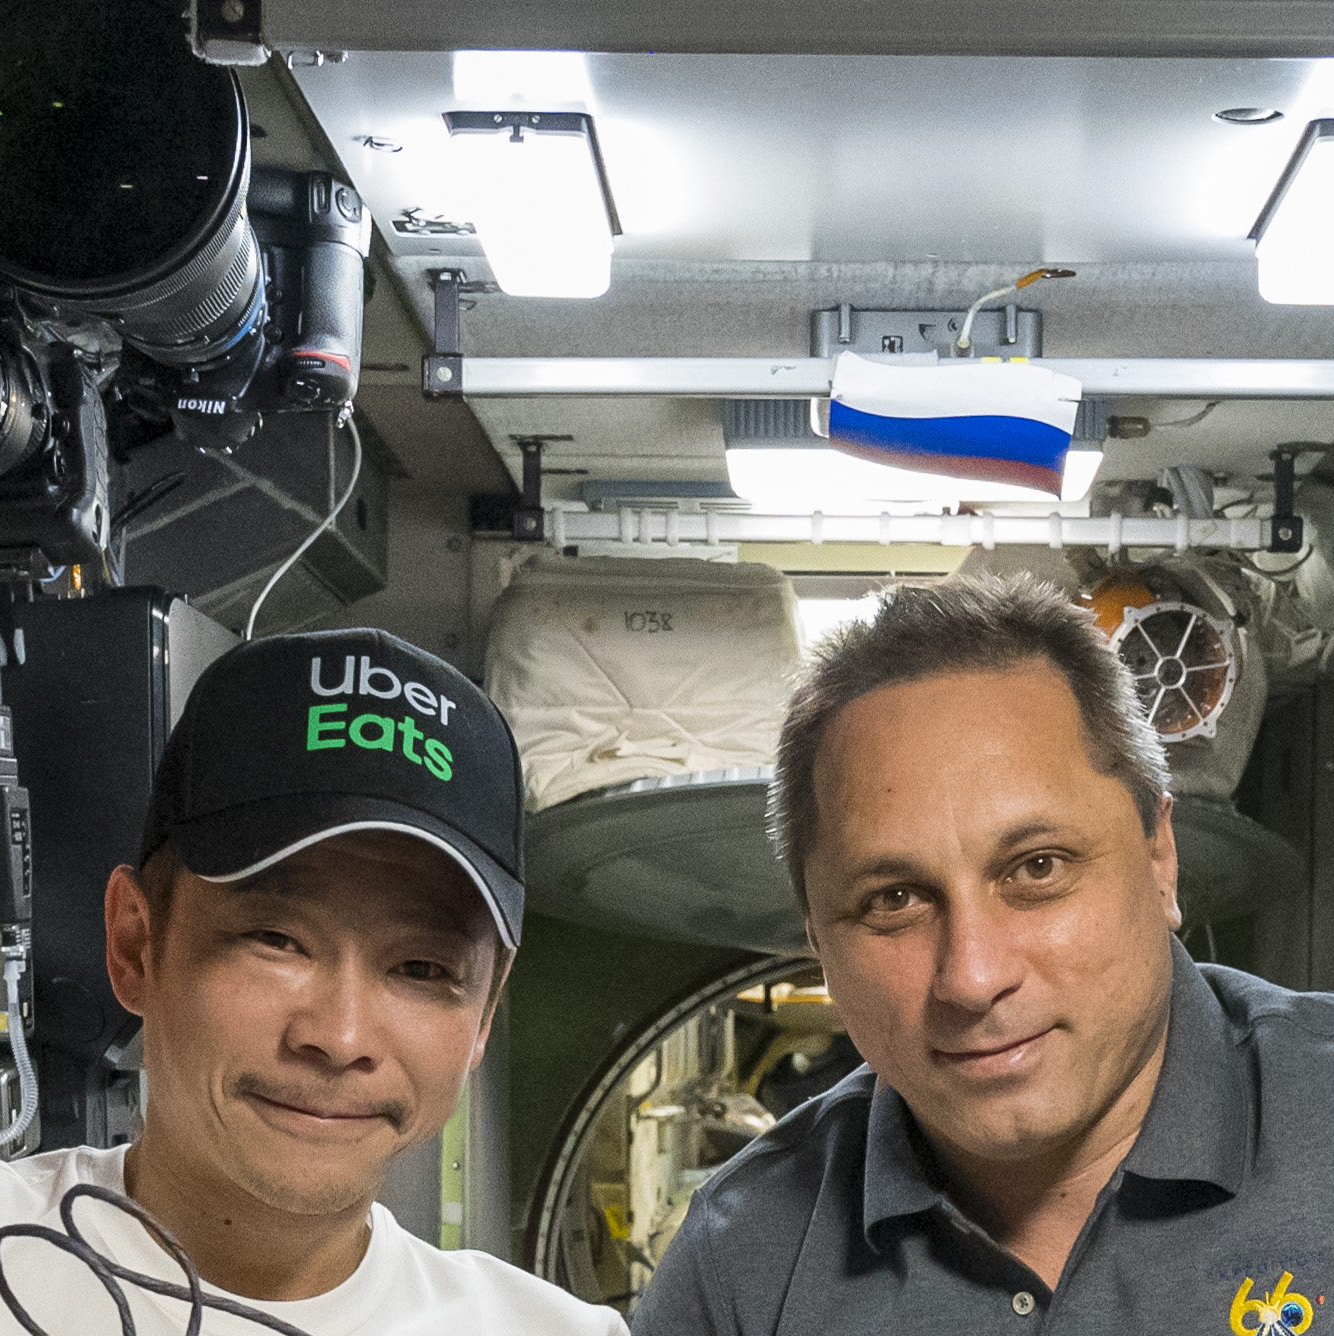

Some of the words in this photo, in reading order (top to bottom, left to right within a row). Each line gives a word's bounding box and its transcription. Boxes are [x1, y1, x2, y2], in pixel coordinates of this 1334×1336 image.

[176, 398, 226, 416] Nikon
[623, 610, 674, 634] 1038
[310, 655, 457, 726] Uber
[306, 703, 454, 782] Eats
